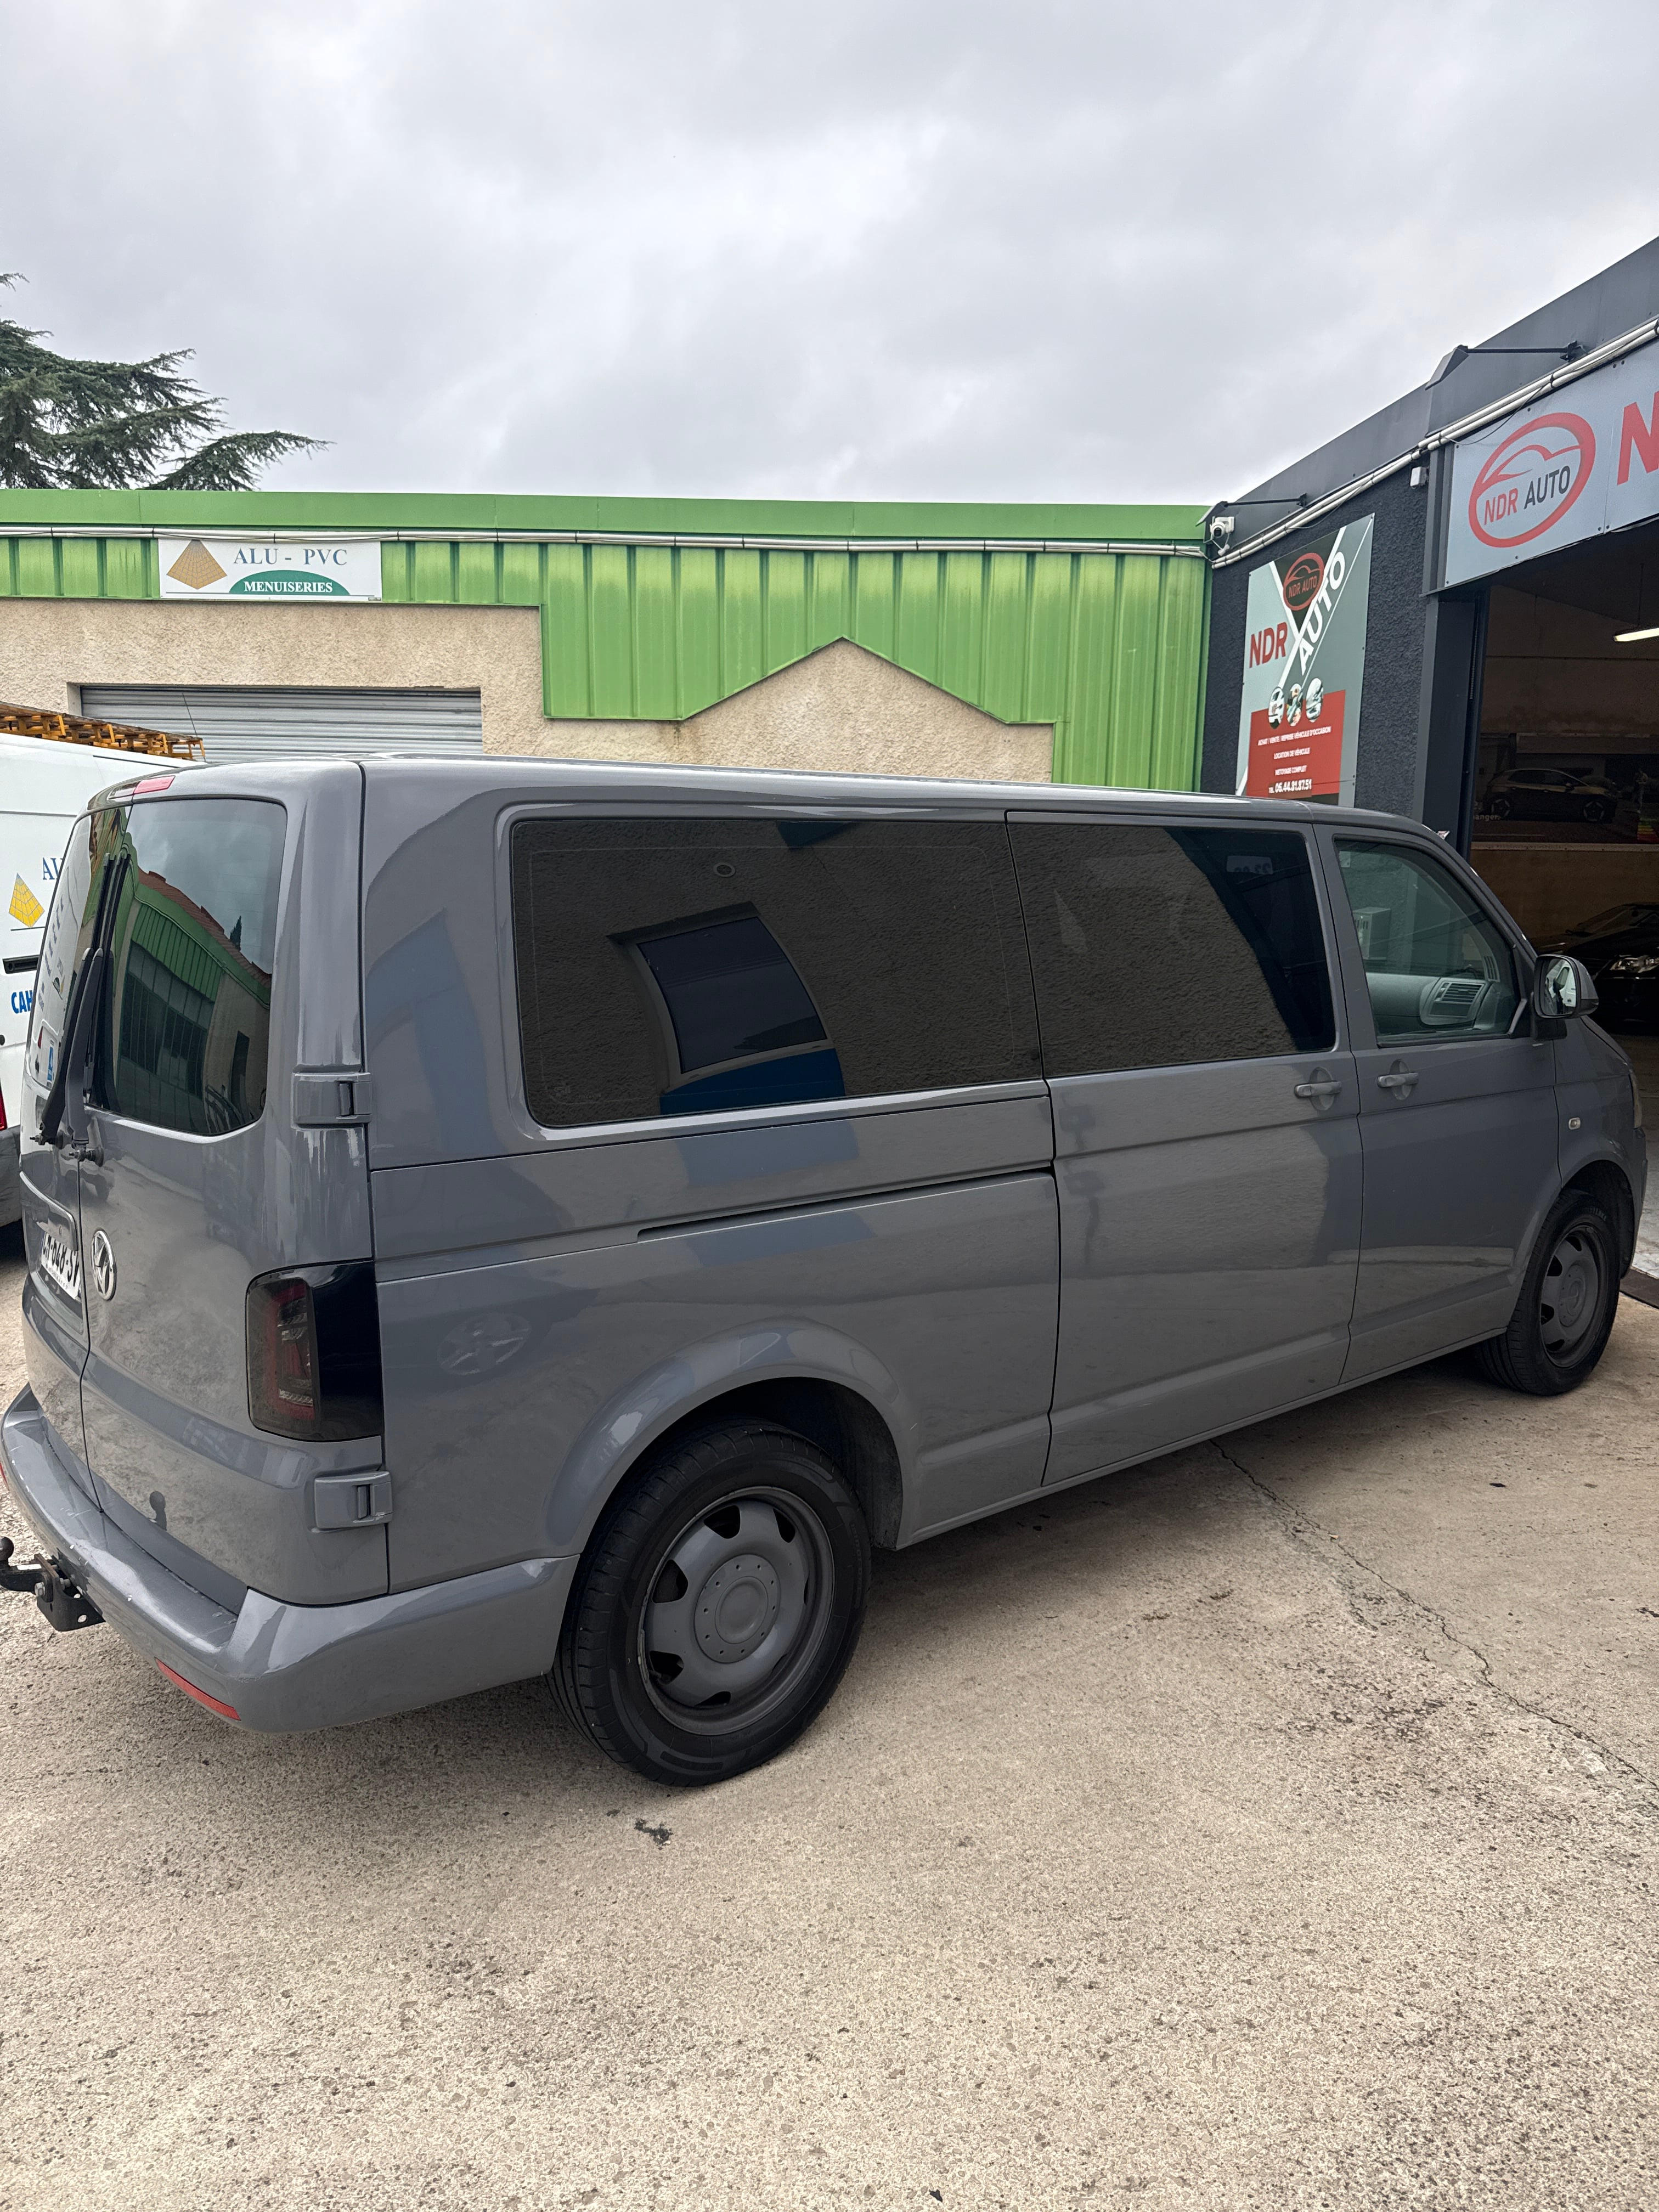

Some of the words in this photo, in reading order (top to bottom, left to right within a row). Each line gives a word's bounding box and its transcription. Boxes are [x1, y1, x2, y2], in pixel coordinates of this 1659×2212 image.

[1484, 488, 1518, 526] NDR
[1523, 465, 1570, 509] AUTO
[233, 548, 279, 565] ALU
[303, 549, 347, 566] PVC
[244, 581, 333, 593] MENUISERIES
[1288, 582, 1301, 599] NDR
[1302, 575, 1317, 592] AUTO
[1249, 622, 1288, 668] NDR
[1299, 551, 1345, 676] AUTO
